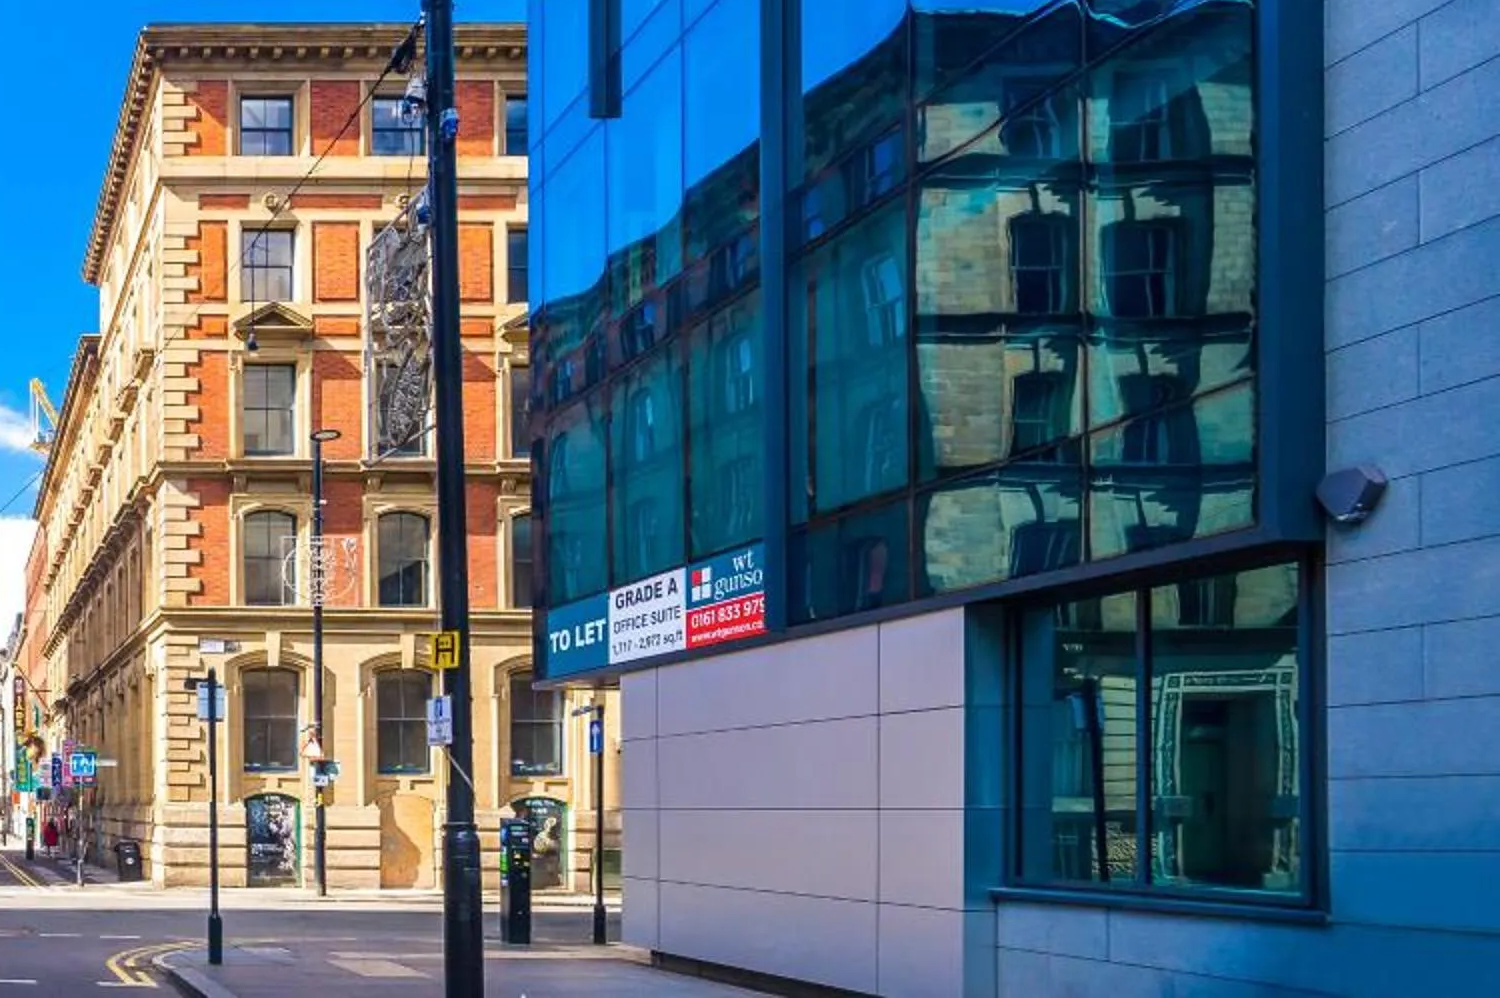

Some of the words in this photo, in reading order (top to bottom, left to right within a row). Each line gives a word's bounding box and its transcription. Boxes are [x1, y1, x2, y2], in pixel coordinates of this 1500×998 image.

[732, 549, 754, 572] wt
[615, 581, 662, 610] GRADE
[667, 577, 678, 596] A
[613, 613, 648, 634] OFFICE
[650, 605, 681, 624] SUITE
[691, 609, 715, 629] 0161
[717, 603, 741, 622] 833
[435, 633, 455, 665] H
[549, 629, 570, 654] TO
[575, 618, 606, 647] LET
